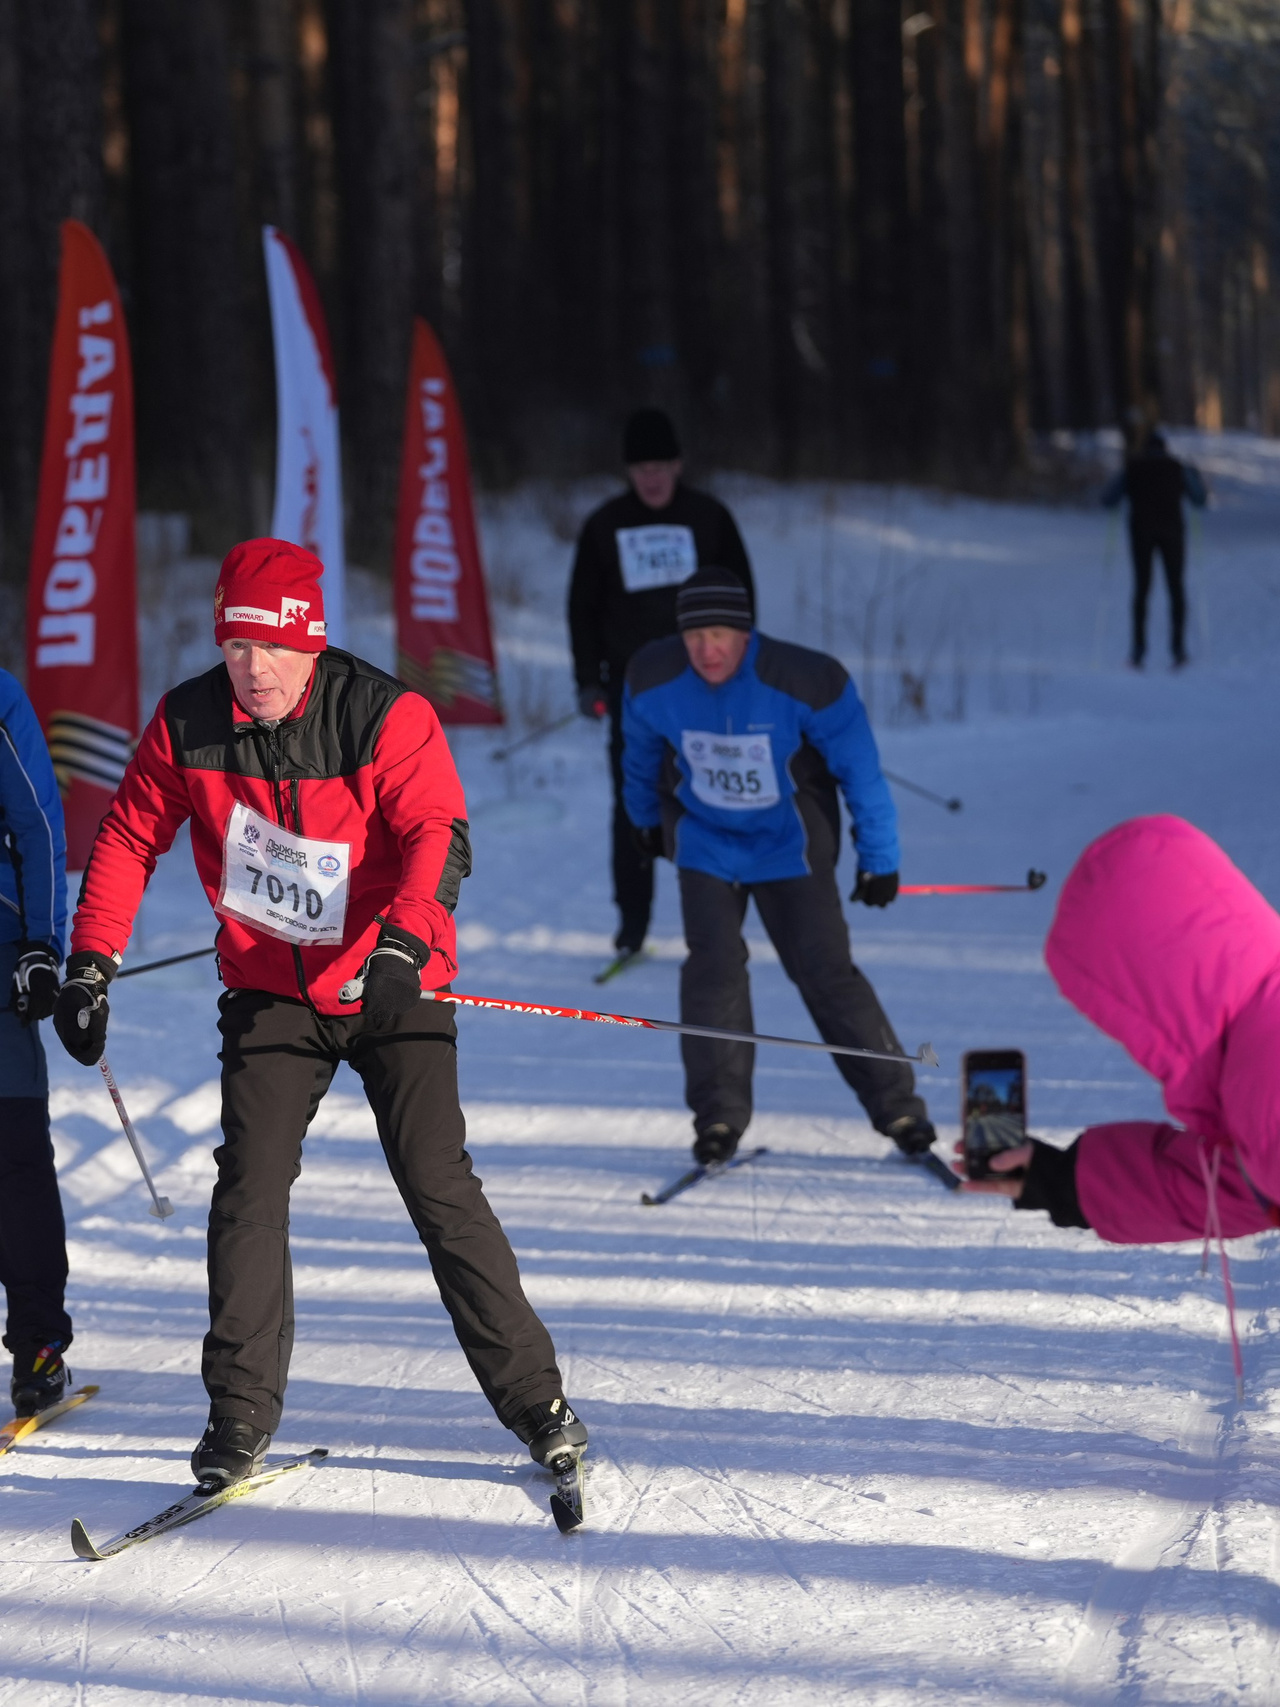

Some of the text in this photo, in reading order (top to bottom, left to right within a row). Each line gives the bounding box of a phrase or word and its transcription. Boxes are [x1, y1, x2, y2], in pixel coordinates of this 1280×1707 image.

[232, 612, 264, 622] FORWARD
[265, 845, 309, 869] РОССИИ
[267, 837, 307, 861] ЛЫЖНЯ
[245, 864, 324, 921] 7010
[265, 907, 308, 932] СВЕРДЛОВСКАЯ
